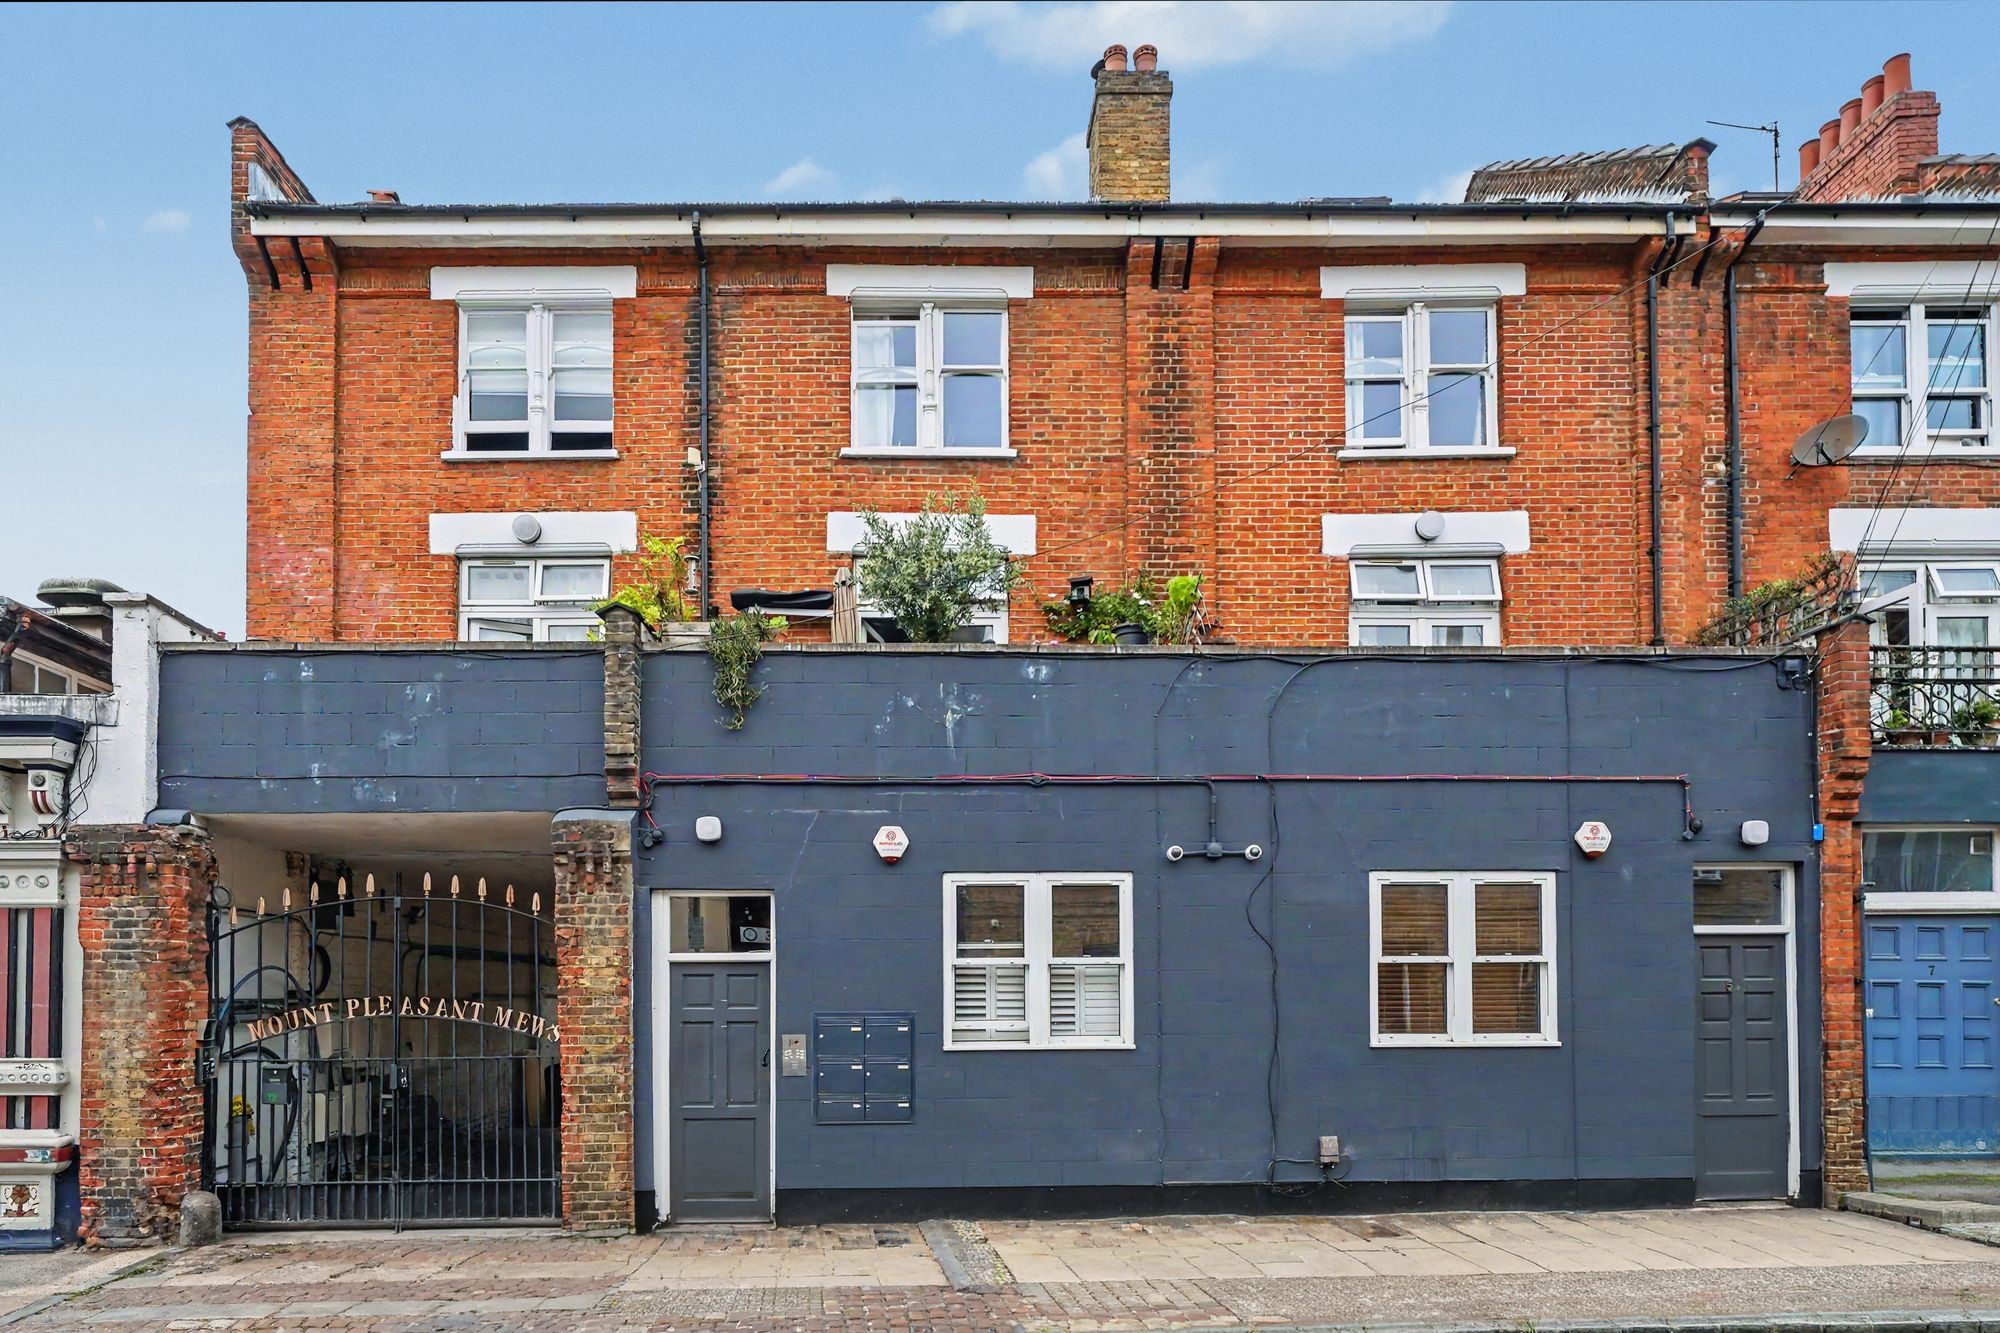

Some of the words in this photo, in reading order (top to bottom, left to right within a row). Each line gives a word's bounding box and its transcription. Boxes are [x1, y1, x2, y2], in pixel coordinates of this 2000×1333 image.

[1927, 965, 1936, 976] 7
[247, 1002, 333, 1042] MOUNT
[346, 995, 485, 1023] PLEASANT
[493, 1006, 560, 1043] MEWS
